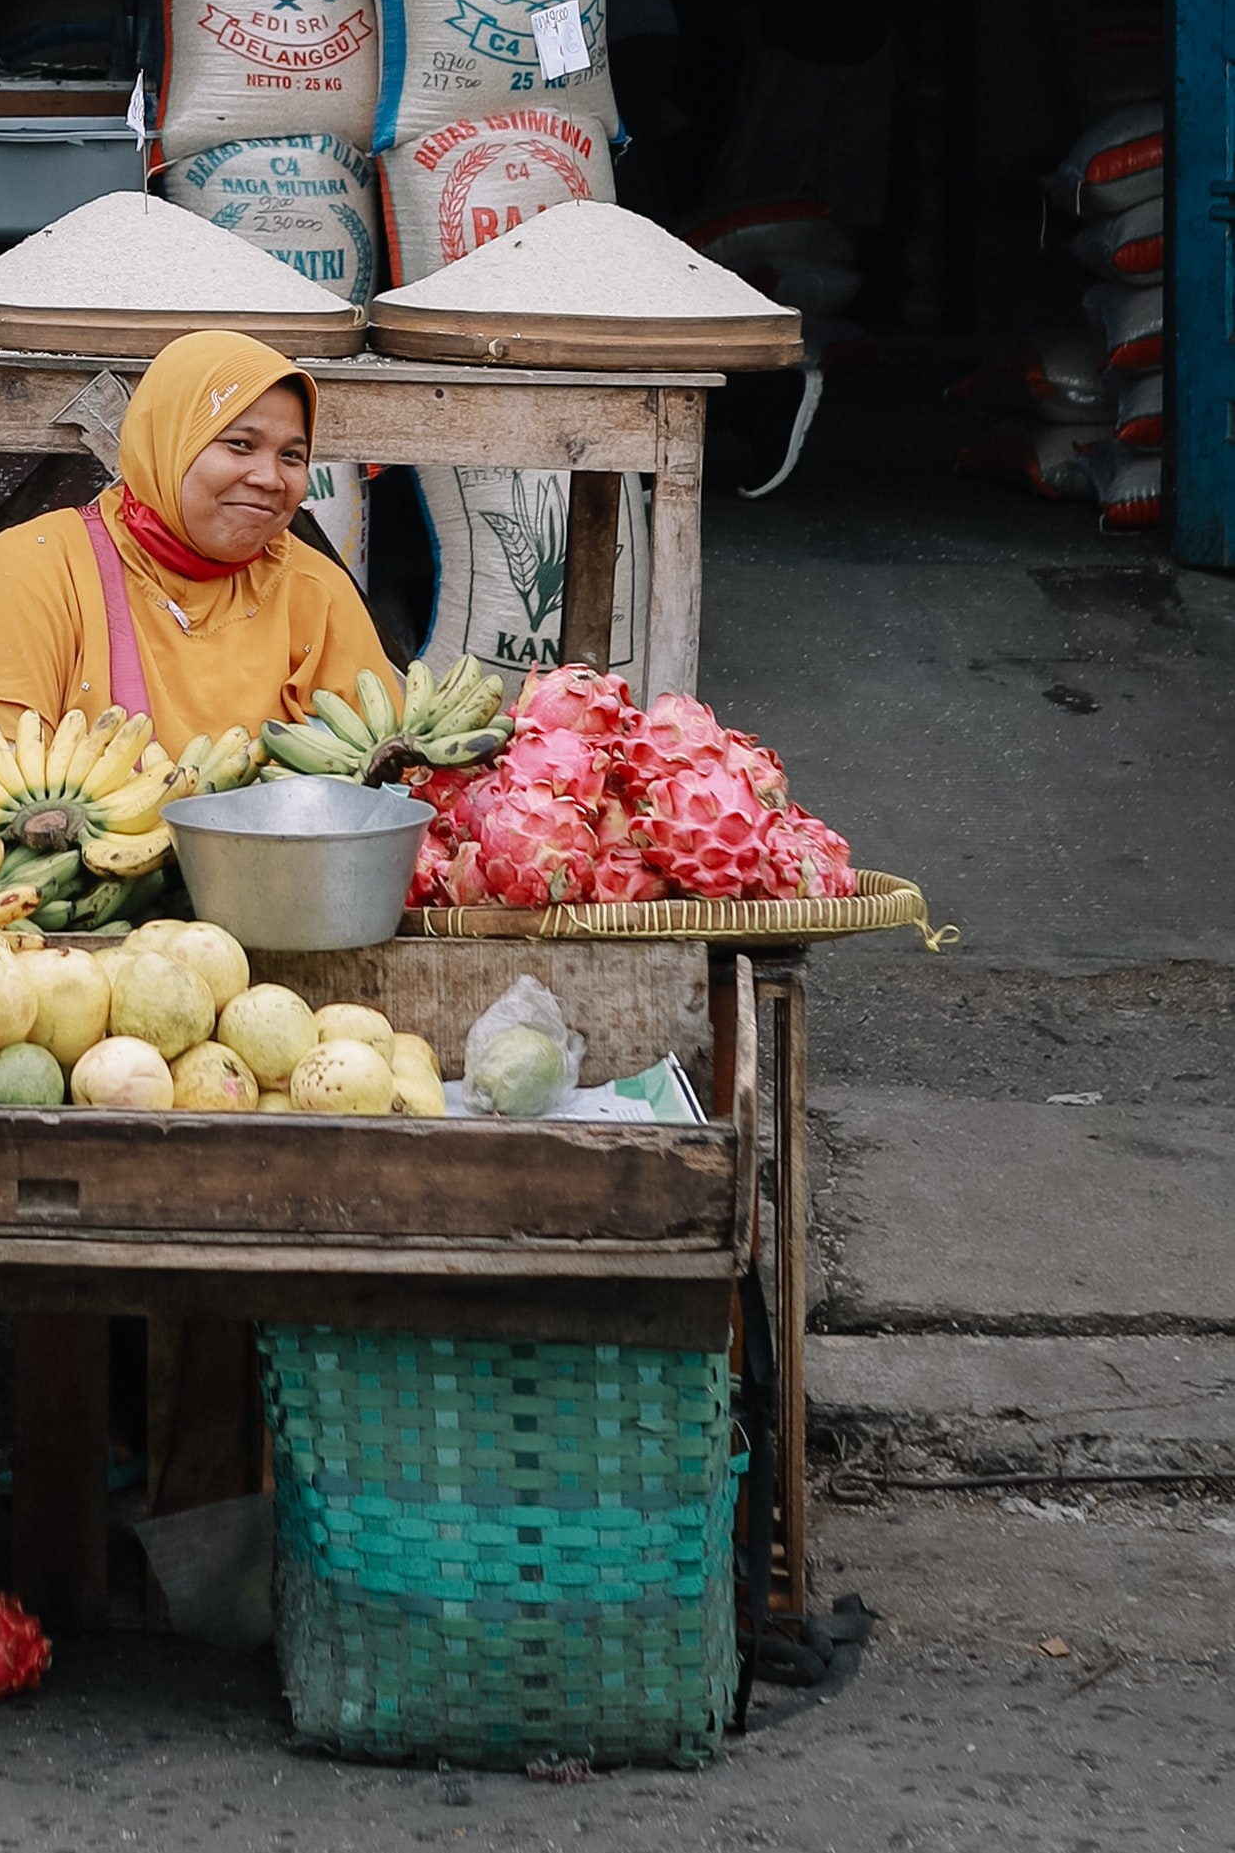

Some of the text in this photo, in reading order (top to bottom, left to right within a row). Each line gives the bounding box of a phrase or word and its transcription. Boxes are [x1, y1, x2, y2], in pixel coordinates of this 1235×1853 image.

[251, 11, 329, 34] EDI SRI
[228, 31, 351, 67] DELANGGU
[488, 33, 520, 56] C4
[246, 73, 293, 90] NETTO
[304, 77, 321, 90] 25
[325, 77, 343, 91] KG
[510, 72, 534, 90] 25
[413, 109, 593, 172] BERAS ISTIMEWA
[270, 156, 302, 178] C4
[319, 133, 371, 190] PULEN
[505, 162, 531, 182] C4
[221, 177, 349, 197] NAGA MUTIARA
